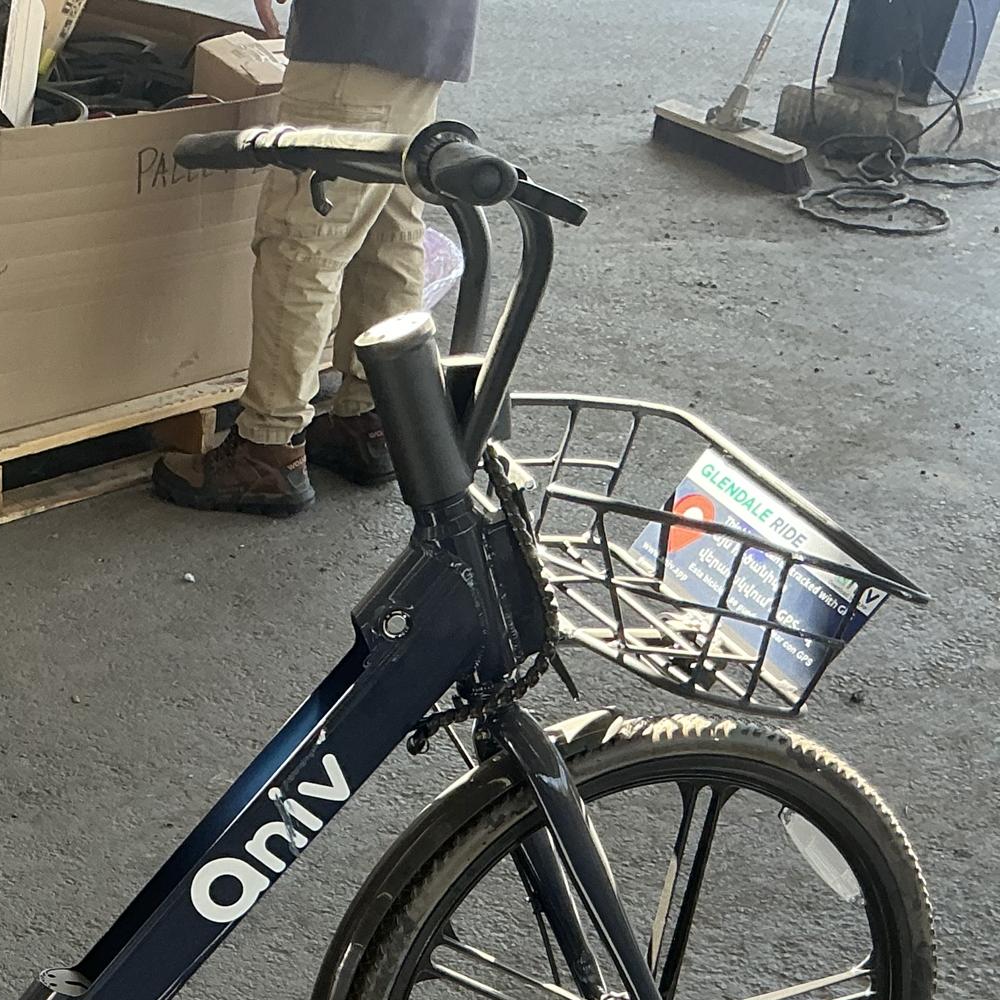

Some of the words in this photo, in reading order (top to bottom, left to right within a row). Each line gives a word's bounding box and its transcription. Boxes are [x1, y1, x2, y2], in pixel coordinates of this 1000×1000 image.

[701, 464, 774, 522] GLENDALE
[769, 517, 808, 548] RIDE
[789, 568, 820, 595] tracked
[817, 591, 839, 610] with
[781, 640, 797, 654] con
[795, 649, 814, 667] GPS
[190, 753, 351, 923] aniv
